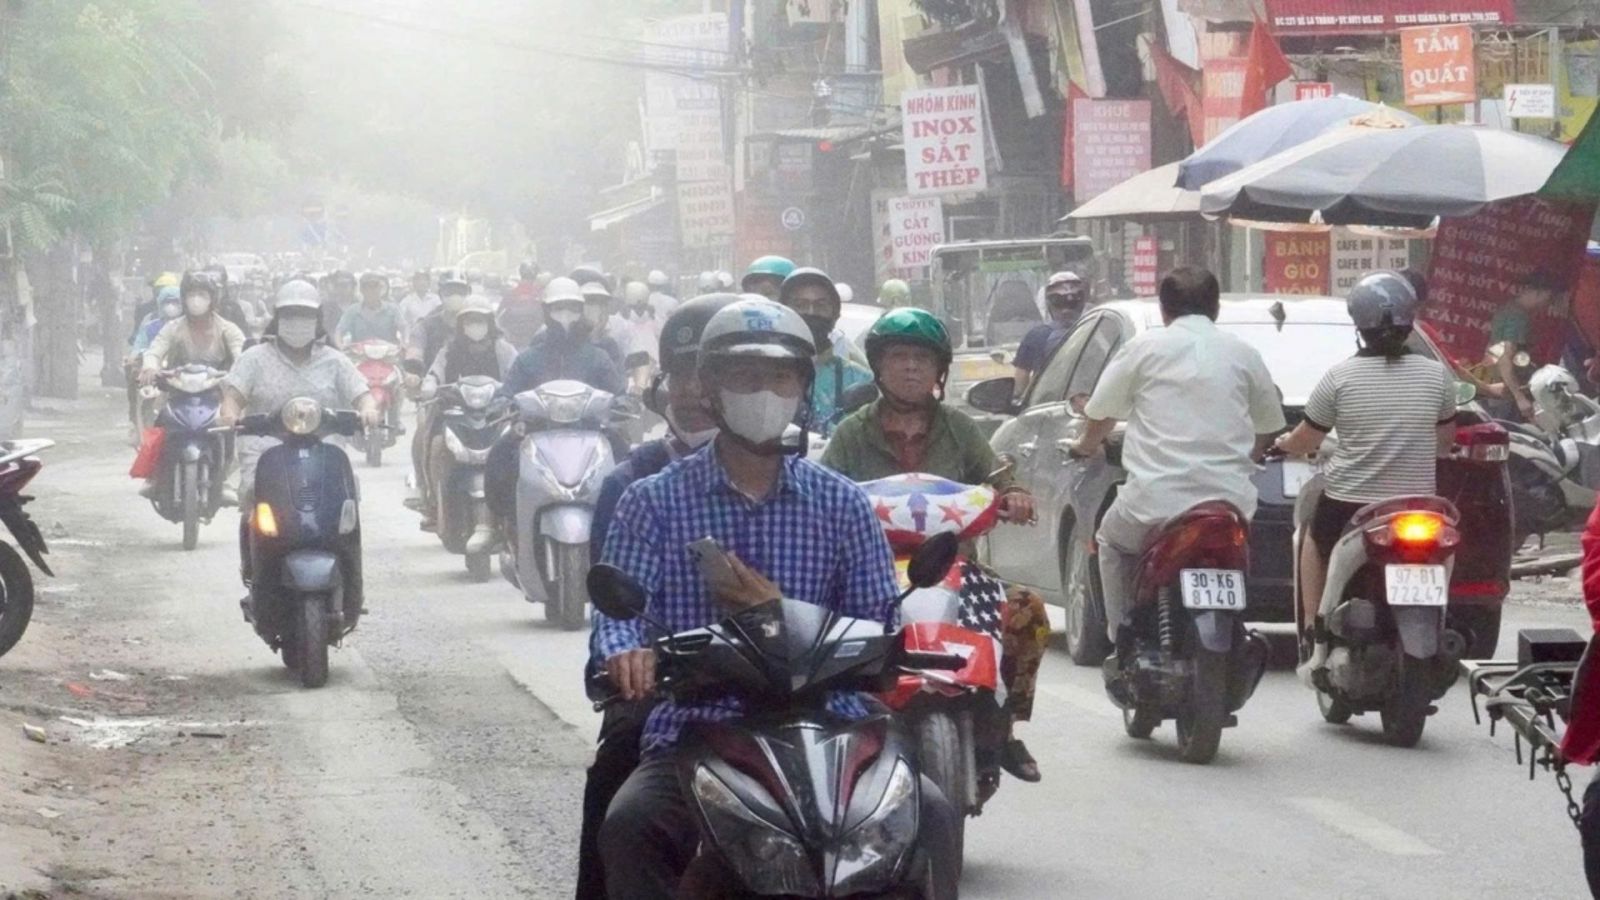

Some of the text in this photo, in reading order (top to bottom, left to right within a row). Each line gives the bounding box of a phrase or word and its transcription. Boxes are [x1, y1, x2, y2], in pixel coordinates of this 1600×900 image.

[1410, 59, 1469, 87] QUẤT
[907, 89, 977, 115] NHÔM KÍNH
[912, 116, 977, 138] INOX
[921, 136, 971, 164] SẮT
[902, 247, 930, 264] KÍN
[1275, 235, 1327, 257] BÁNH
[1284, 258, 1320, 280] GIÒ
[1337, 257, 1359, 270] CAFE
[1190, 572, 1235, 589] 30-K6
[1191, 589, 1236, 606] 8140
[1390, 585, 1444, 603] 722.47
